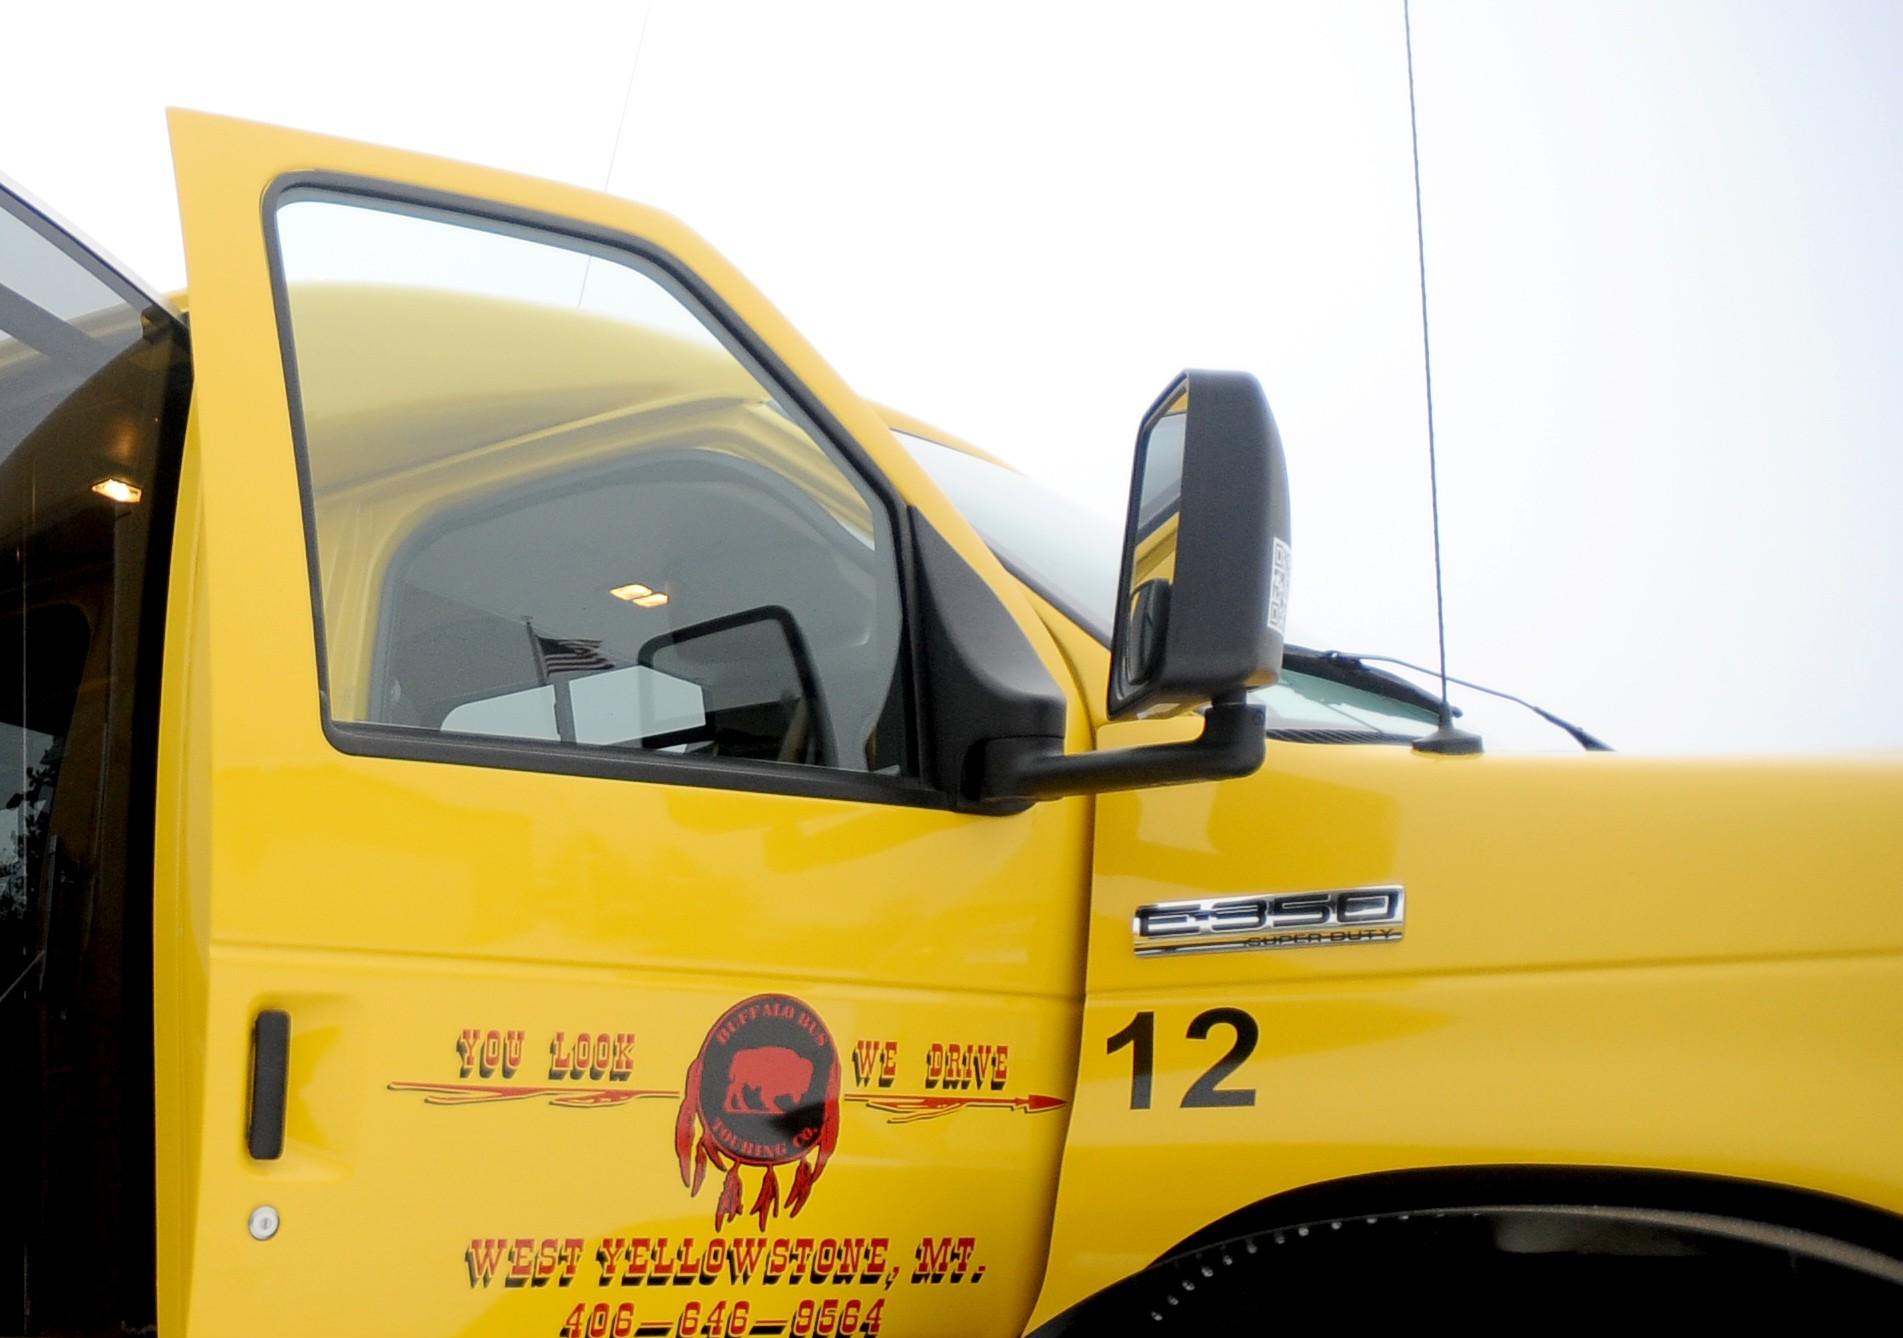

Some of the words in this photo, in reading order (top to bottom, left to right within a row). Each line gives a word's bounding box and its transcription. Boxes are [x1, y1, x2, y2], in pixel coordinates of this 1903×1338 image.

[1245, 932, 1323, 948] SUPER
[1328, 928, 1395, 943] DUTY
[715, 1003, 795, 1046] BUFFALO
[798, 1012, 828, 1047] BUS
[456, 1029, 526, 1079] YOU
[548, 1031, 636, 1082] LOOK
[852, 1040, 898, 1088] WE
[925, 1043, 1009, 1091] DRIVE
[1106, 1006, 1259, 1111] 12
[712, 1117, 788, 1157] TOURING
[464, 1238, 584, 1289] WEST
[595, 1237, 900, 1291] YELLOWSTONE,
[910, 1236, 987, 1285] MT.
